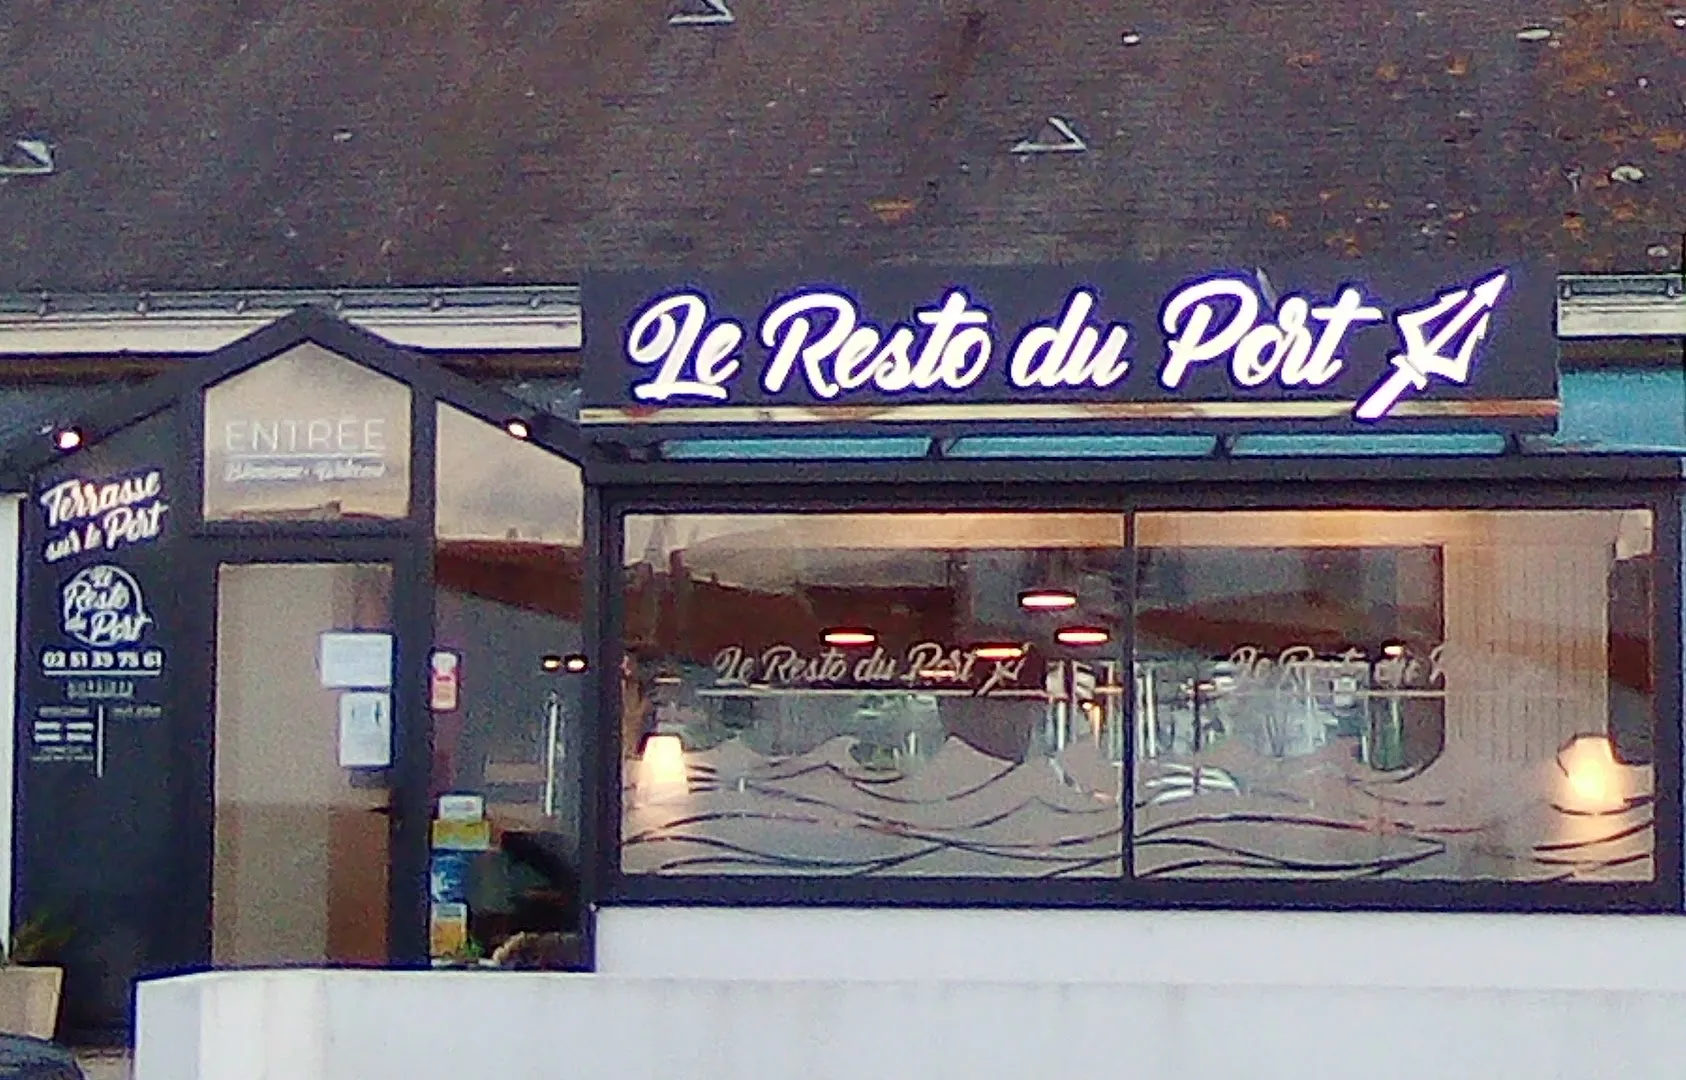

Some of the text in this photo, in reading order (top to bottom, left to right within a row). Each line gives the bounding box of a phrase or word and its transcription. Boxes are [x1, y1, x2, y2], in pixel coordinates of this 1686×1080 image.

[628, 277, 1386, 401] Le Resto du Port
[224, 412, 386, 451] ENTRÉE
[40, 471, 161, 528] Terrasse
[103, 500, 169, 550] Port
[89, 609, 153, 642] Port
[713, 645, 753, 687] Le
[761, 644, 847, 684] Resto
[853, 646, 898, 684] du
